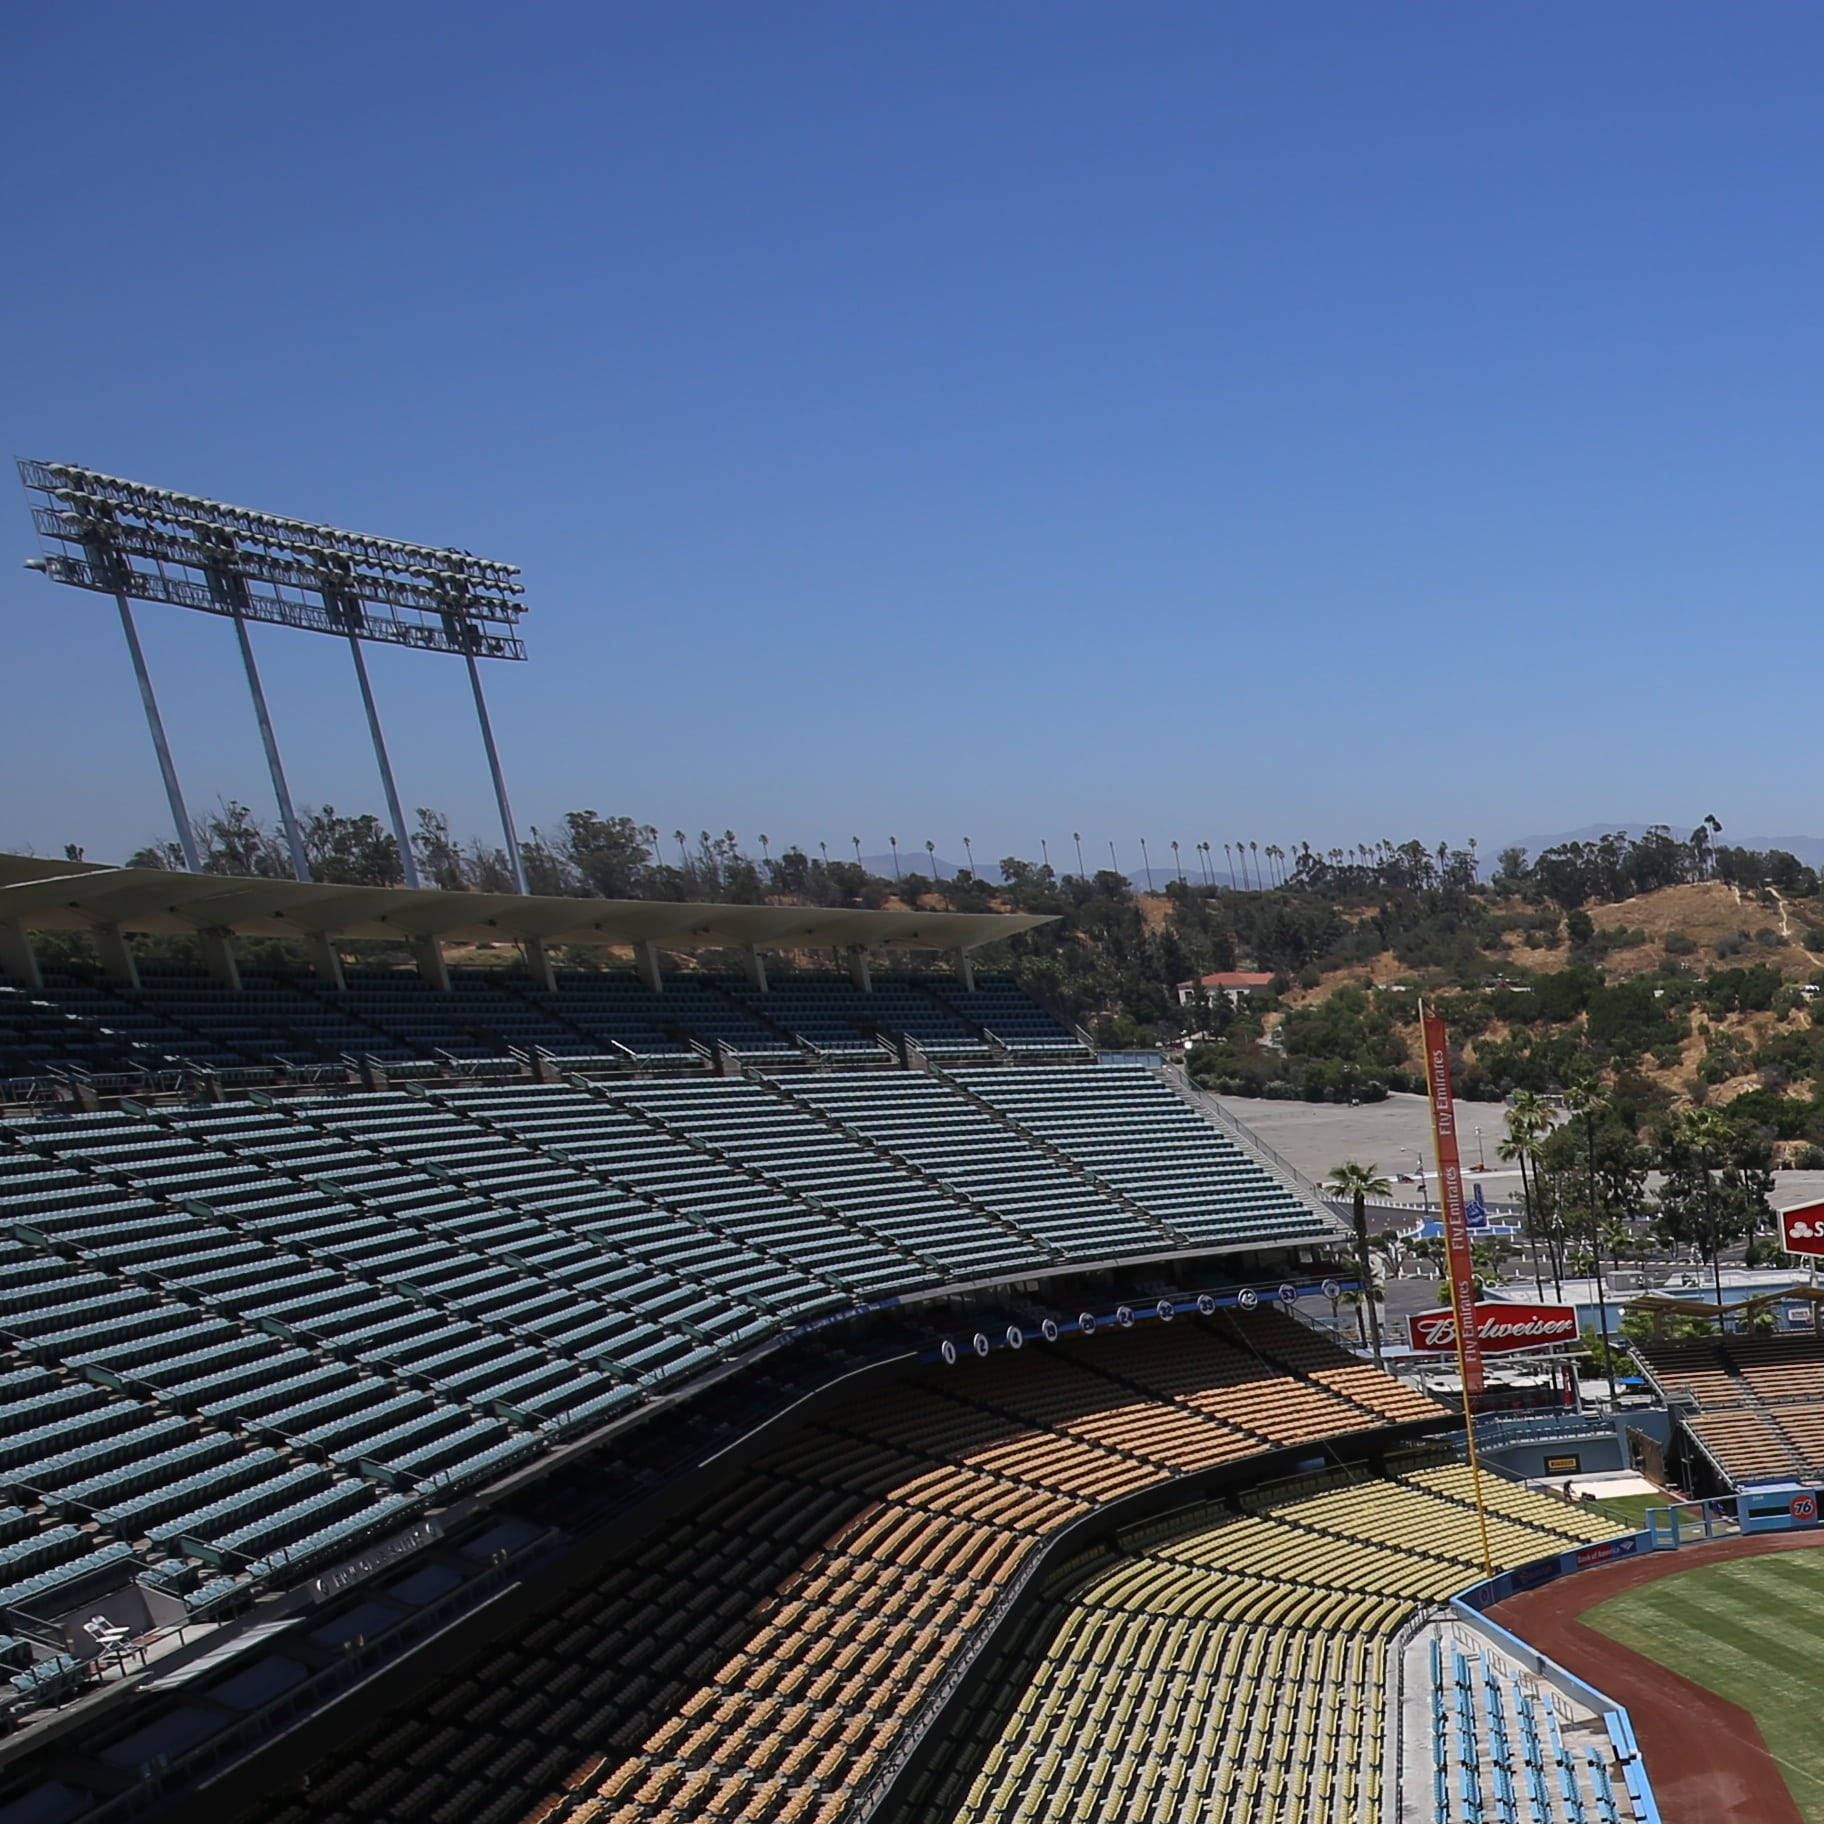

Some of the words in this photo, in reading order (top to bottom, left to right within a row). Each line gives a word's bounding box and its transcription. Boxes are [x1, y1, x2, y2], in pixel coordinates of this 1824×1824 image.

[1432, 1049, 1448, 1109] Emirates
[1439, 1112, 1453, 1135] Fly
[1446, 1166, 1463, 1225] Emirates
[1451, 1228, 1466, 1250] Fly
[1417, 1316, 1573, 1346] Bdweiser
[1794, 1501, 1812, 1515] 76
